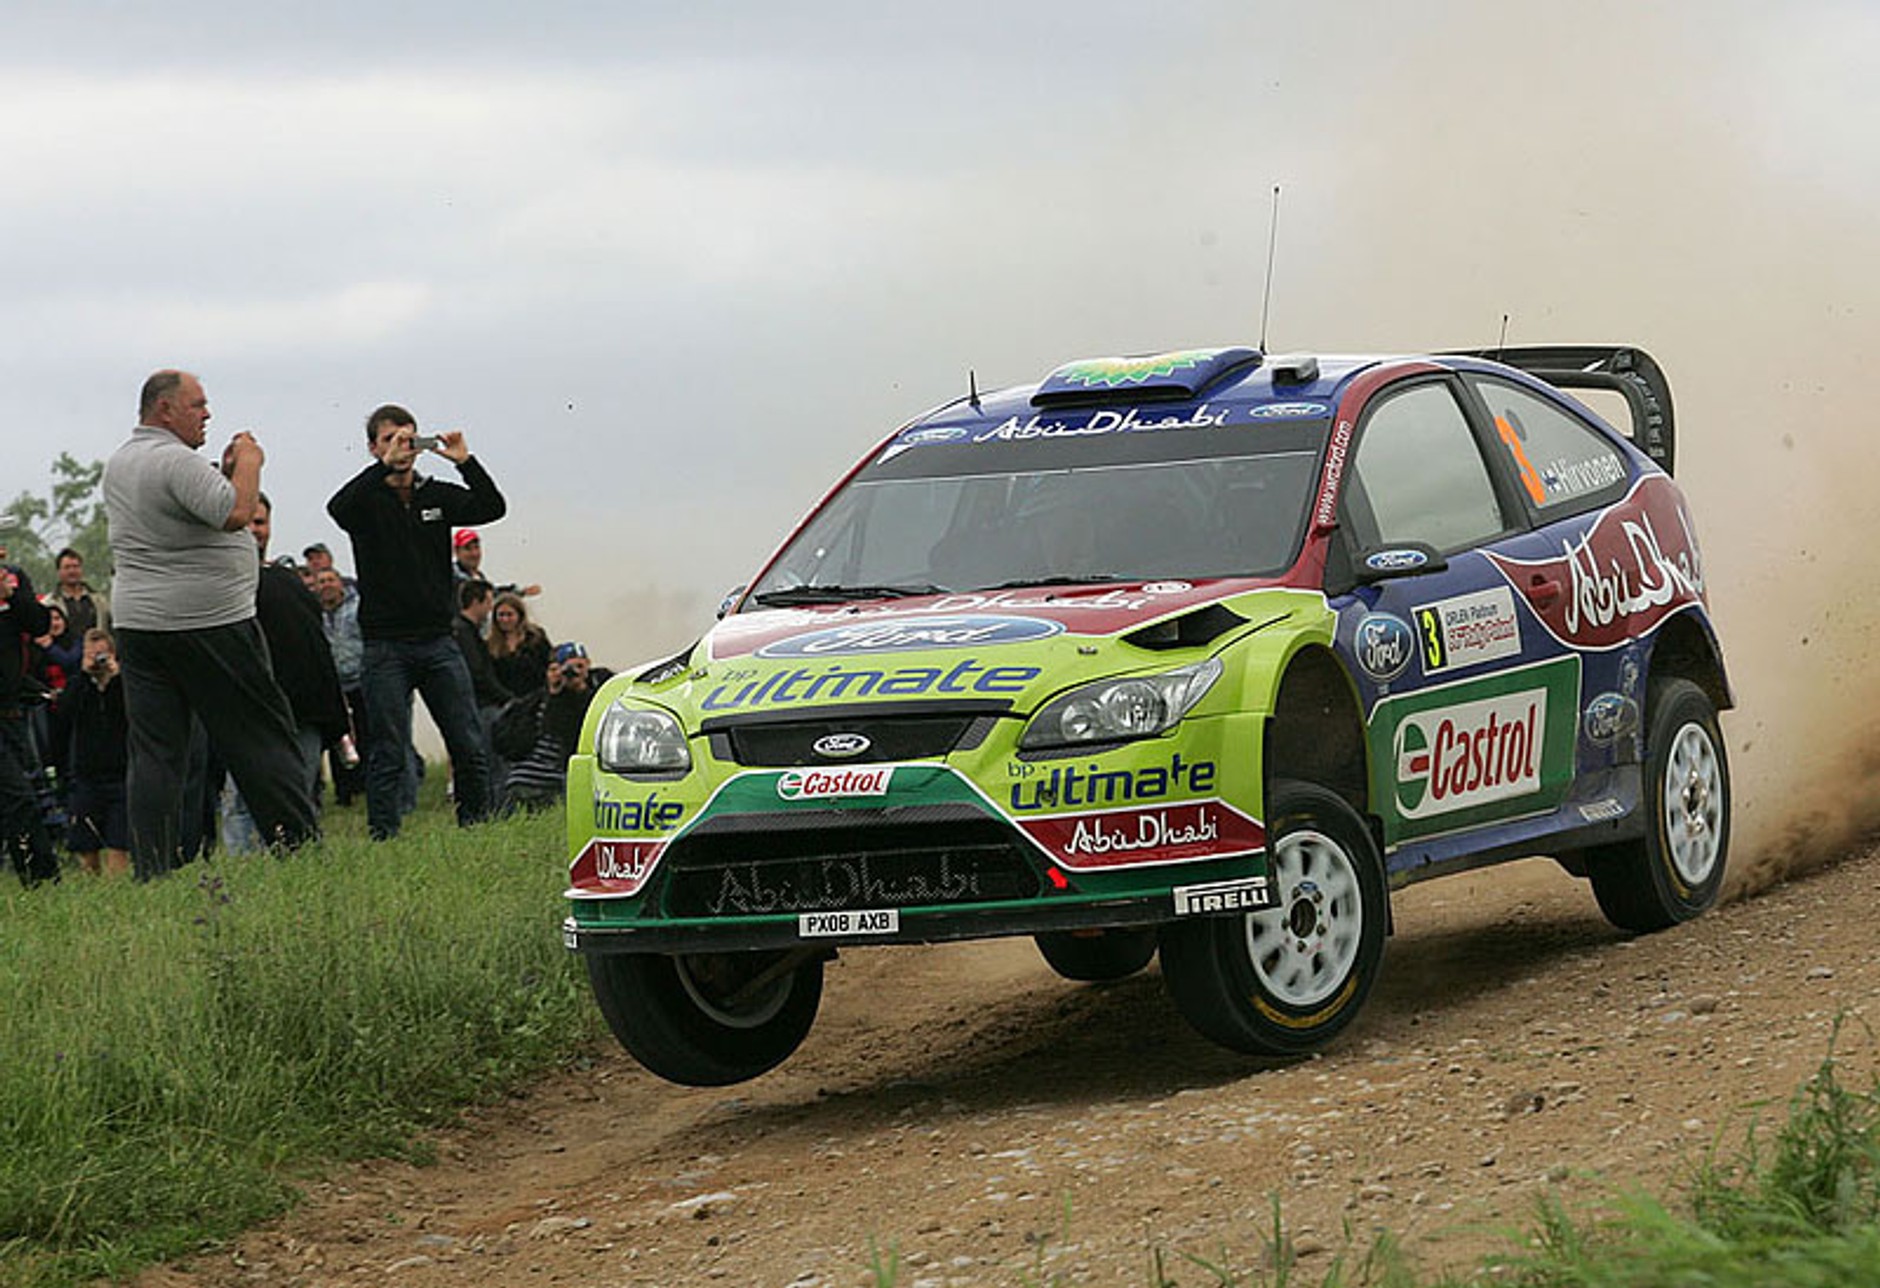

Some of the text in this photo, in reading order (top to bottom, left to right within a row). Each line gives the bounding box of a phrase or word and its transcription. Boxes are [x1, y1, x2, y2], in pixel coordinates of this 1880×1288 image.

[973, 404, 1230, 443] Abu Dhabi
[1563, 530, 1632, 635] Abu
[799, 617, 1010, 654] Ford
[1364, 623, 1401, 669] Ford
[1423, 610, 1441, 667] 3
[701, 658, 1043, 711] ultimate
[1008, 762, 1035, 779] bp
[1431, 702, 1537, 800] Castrol
[803, 771, 885, 796] Castrol
[1010, 753, 1216, 810] ultimate
[1064, 807, 1218, 855] Abu Dhabi
[706, 852, 981, 914] Abu Dhabi
[1172, 877, 1269, 916] PIRELLI
[857, 912, 891, 931] AXB
